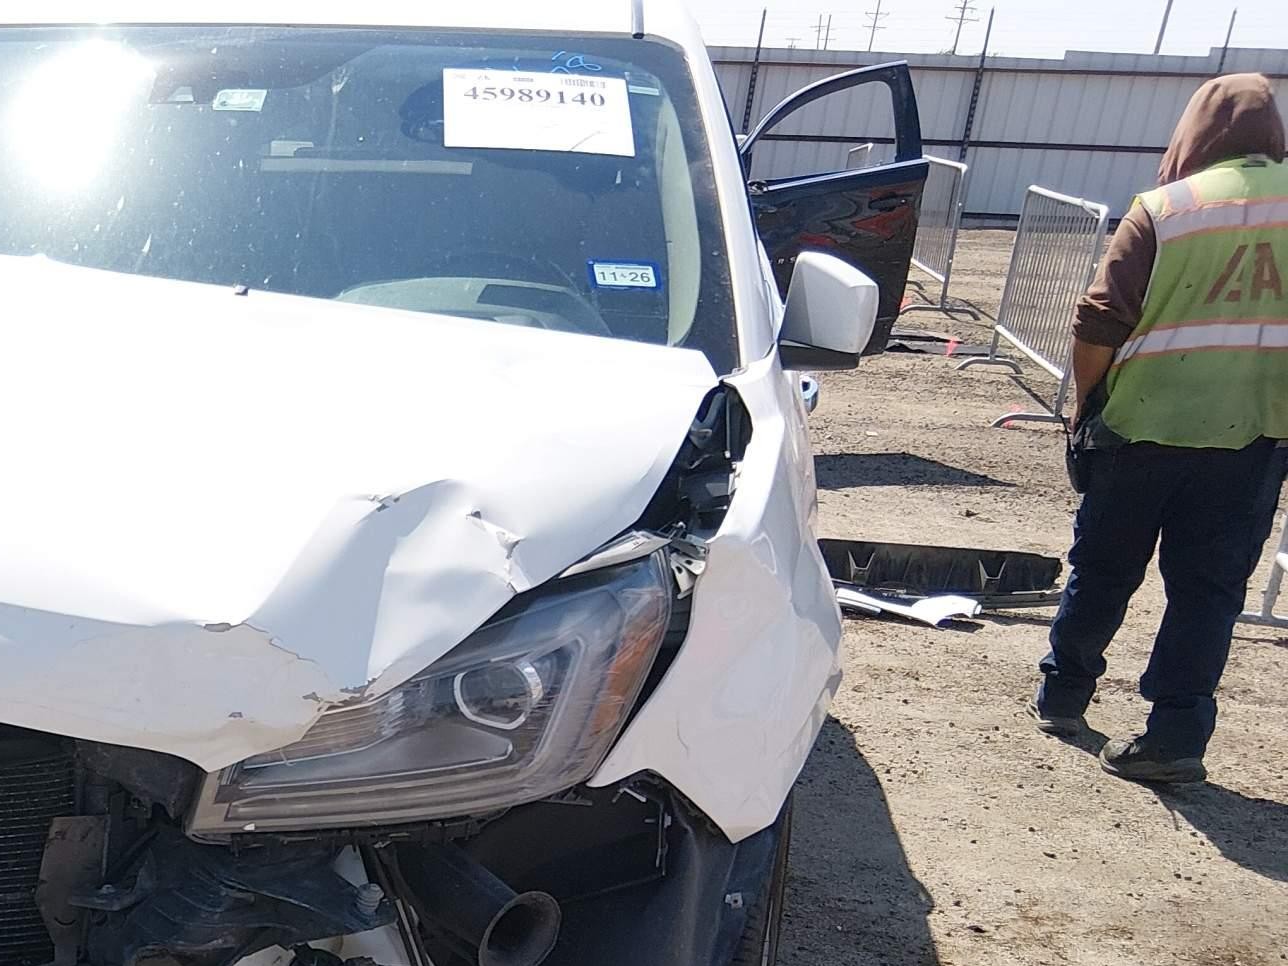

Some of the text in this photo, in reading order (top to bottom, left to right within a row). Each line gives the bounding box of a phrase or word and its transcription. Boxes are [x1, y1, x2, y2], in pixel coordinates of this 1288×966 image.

[463, 86, 606, 107] 45989140
[598, 271, 651, 283] 11 26
